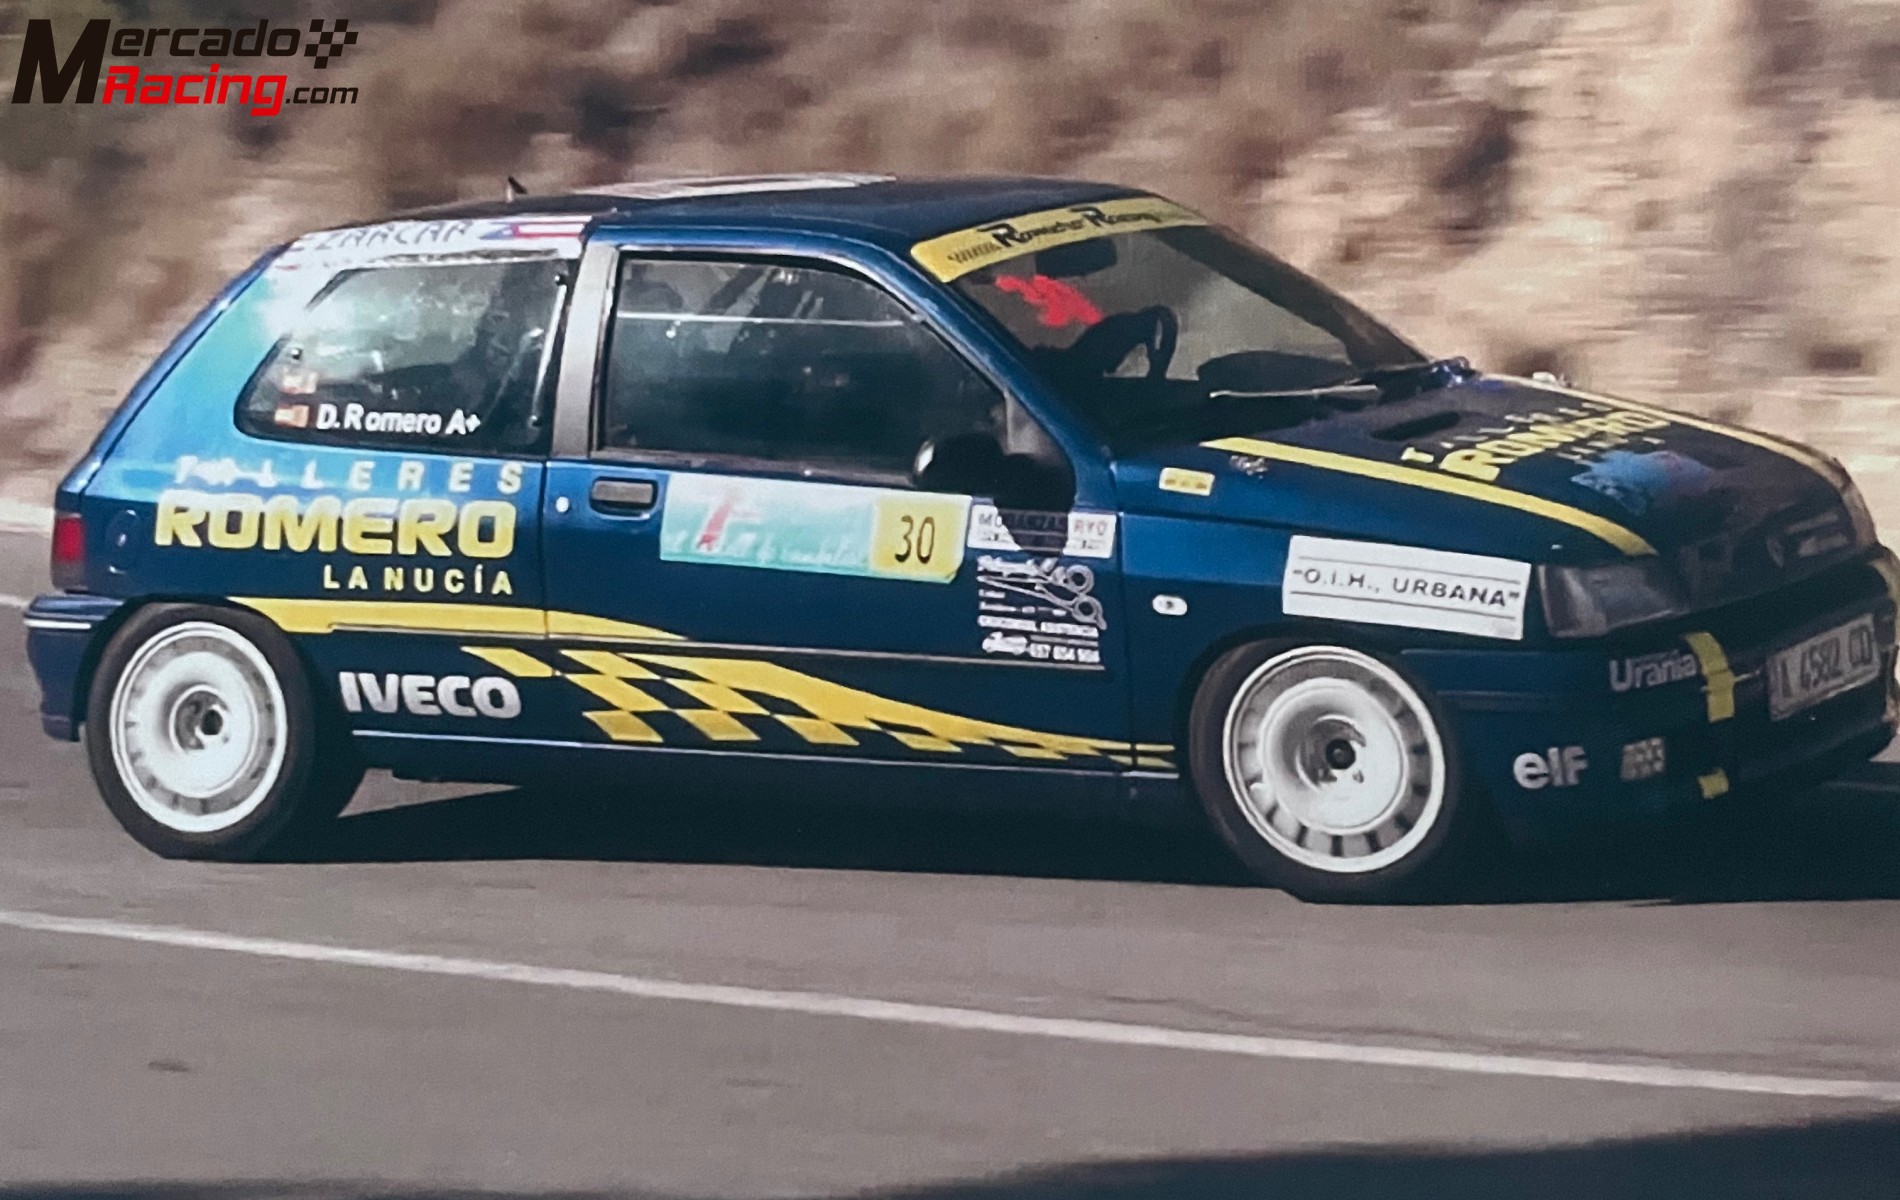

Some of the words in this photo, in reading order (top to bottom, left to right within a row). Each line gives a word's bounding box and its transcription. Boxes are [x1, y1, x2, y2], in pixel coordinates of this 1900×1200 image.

[344, 403, 442, 433] Romero
[154, 489, 516, 559] ROMERO
[894, 515, 936, 564] 30
[323, 564, 368, 590] LA
[384, 564, 514, 595] NUCÍA
[338, 671, 522, 719] IVECO
